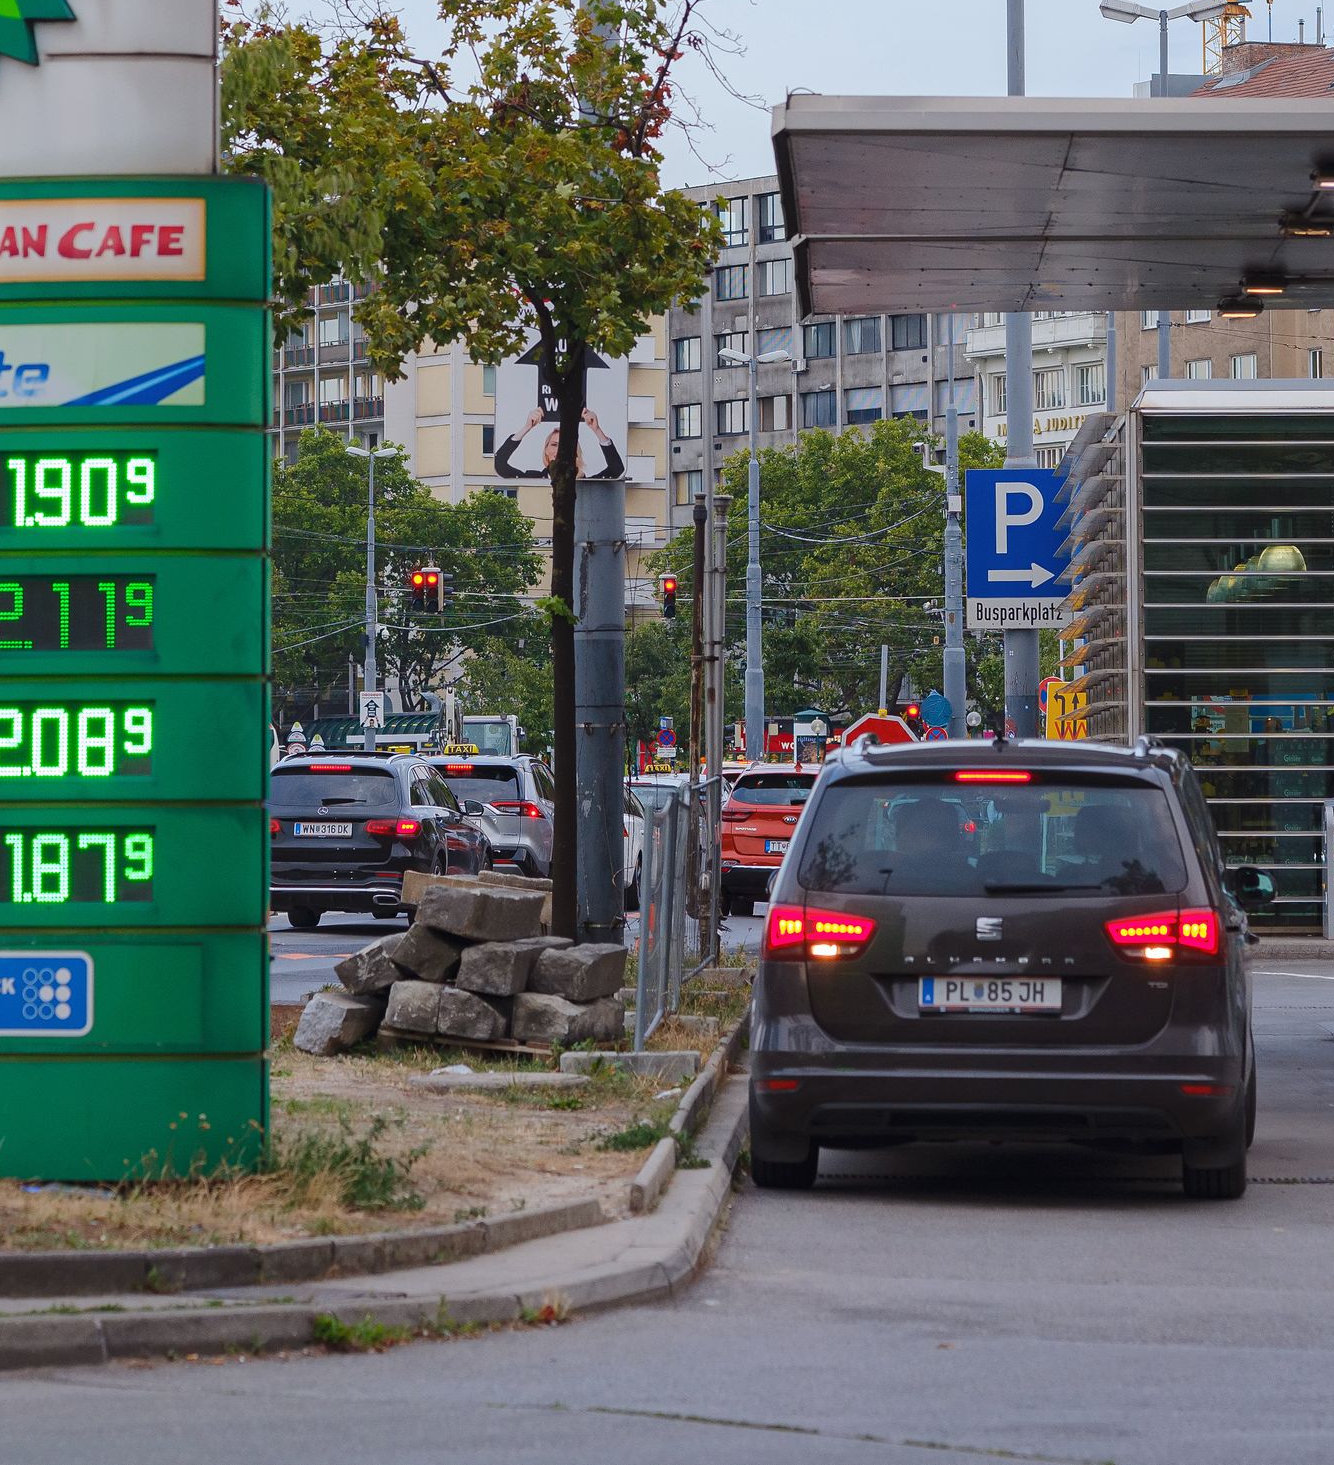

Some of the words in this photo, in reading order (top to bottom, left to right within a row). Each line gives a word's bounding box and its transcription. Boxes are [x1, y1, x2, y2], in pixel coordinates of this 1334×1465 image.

[57, 221, 185, 260] CAFE
[995, 481, 1044, 554] P
[945, 981, 970, 1002] PL
[987, 981, 1013, 1002] 85
[1018, 981, 1045, 1003] JH
